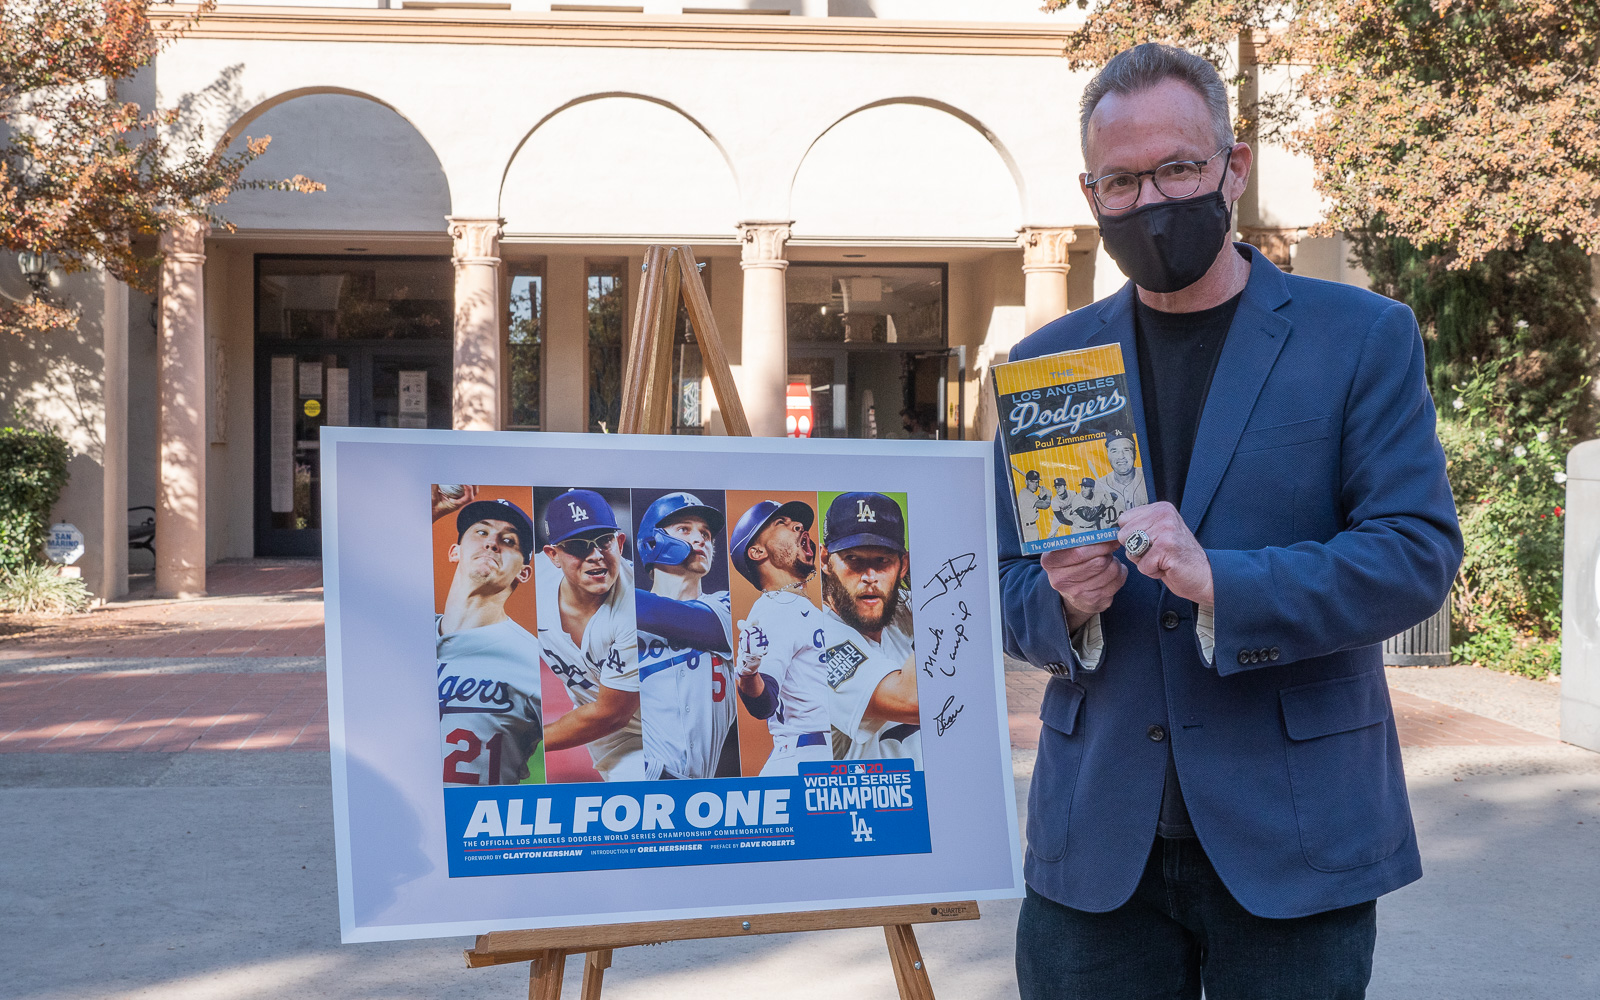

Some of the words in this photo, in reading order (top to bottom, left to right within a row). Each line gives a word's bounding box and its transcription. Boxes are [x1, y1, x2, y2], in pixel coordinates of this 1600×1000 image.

[1050, 368, 1074, 379] THE
[1012, 390, 1041, 404] LOS
[1046, 377, 1115, 398] ANGELES
[1010, 388, 1127, 437] Dodgers
[1035, 438, 1054, 448] Paul
[1057, 432, 1106, 445] Zimmerman
[568, 502, 589, 522] LA
[857, 500, 876, 522] LA
[1097, 530, 1118, 540] SPORT
[828, 650, 862, 686] SERIES
[443, 728, 502, 785] 21
[830, 765, 847, 775] 20
[867, 763, 883, 773] 20
[804, 776, 857, 787] WORLD
[861, 774, 911, 785] SERIES
[805, 785, 913, 811] CHAMPIONS
[463, 798, 562, 838] ALL
[573, 794, 675, 833] FOR
[685, 789, 790, 828] ONE
[714, 828, 773, 836] COMMEMORATIVE
[850, 811, 872, 842] LA
[503, 852, 541, 860] CLAYTON
[659, 844, 702, 852] HERSHISER
